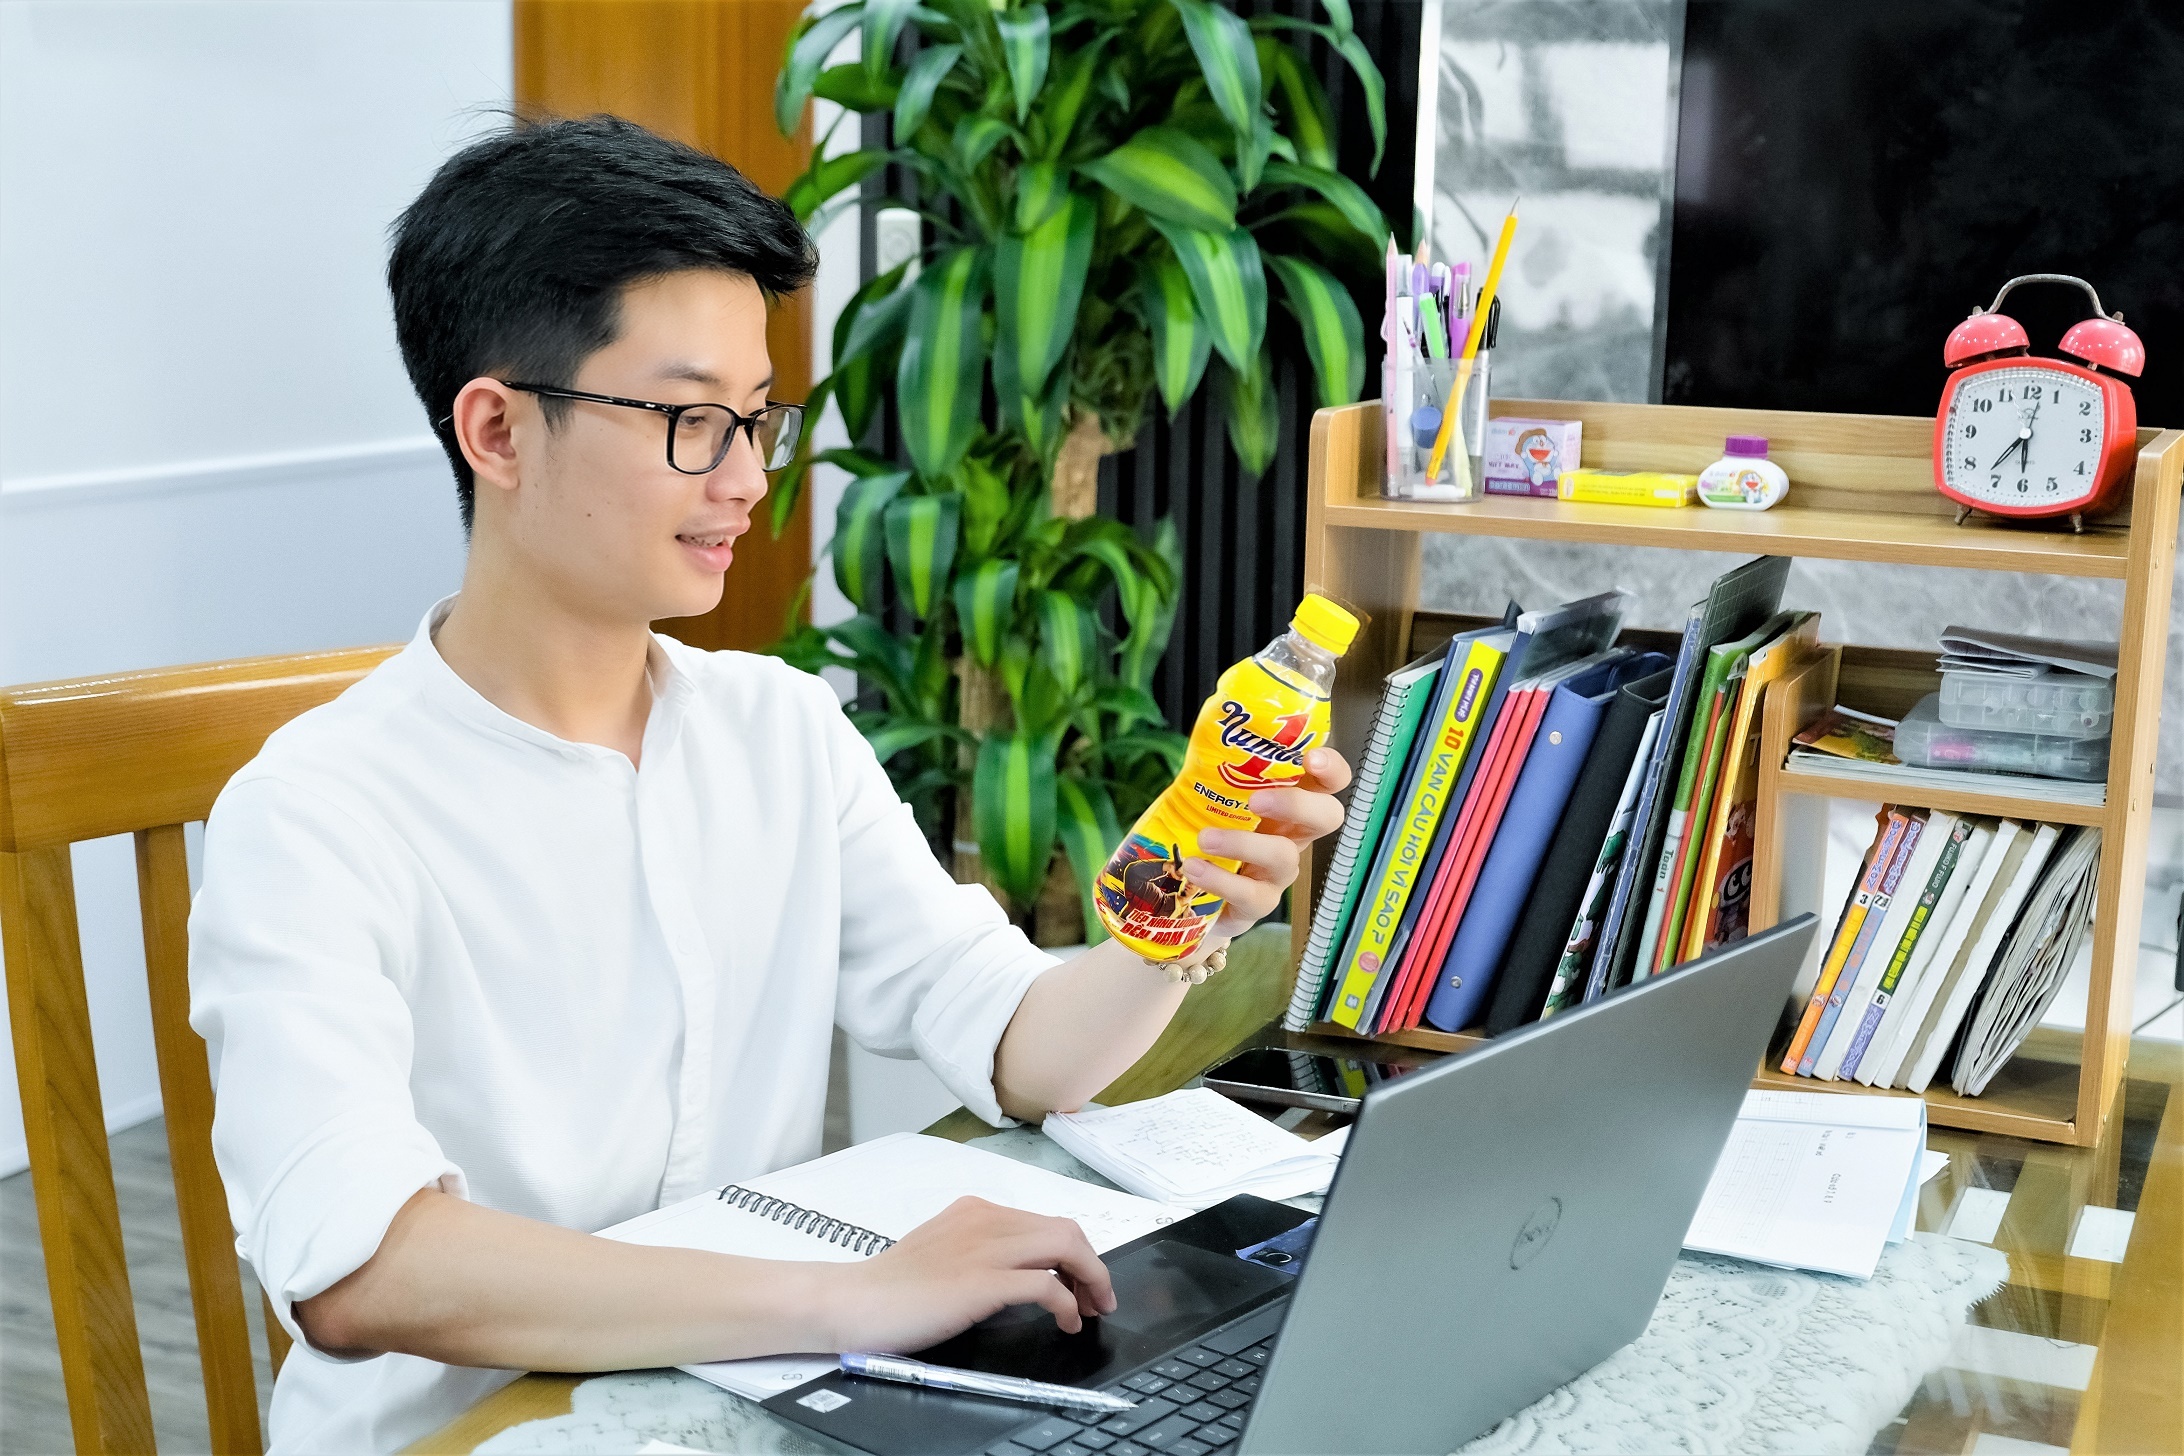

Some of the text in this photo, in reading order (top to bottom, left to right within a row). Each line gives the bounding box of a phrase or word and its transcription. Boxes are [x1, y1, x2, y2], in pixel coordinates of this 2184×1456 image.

[2023, 385, 2043, 401] 12
[2053, 389, 2060, 404] 1
[1973, 398, 1992, 413] 10
[2079, 401, 2091, 416] 2
[1965, 424, 1977, 439] 9
[2079, 428, 2092, 444] 3
[1964, 456, 1977, 471] 8
[2073, 461, 2086, 476] 4
[1990, 474, 2002, 489] 7
[2016, 478, 2029, 493] 6
[2046, 477, 2059, 492] 5
[1444, 726, 1464, 750] 10
[1428, 753, 1453, 791] VẠN
[1193, 781, 1243, 809] ENERGY
[1206, 804, 1229, 817] LIMITED
[1413, 793, 1436, 832] CÂU
[1399, 833, 1422, 866] HỎI
[1942, 842, 1958, 865] FUJIKO
[1859, 894, 1869, 905] 3
[1376, 888, 1400, 928] SAO
